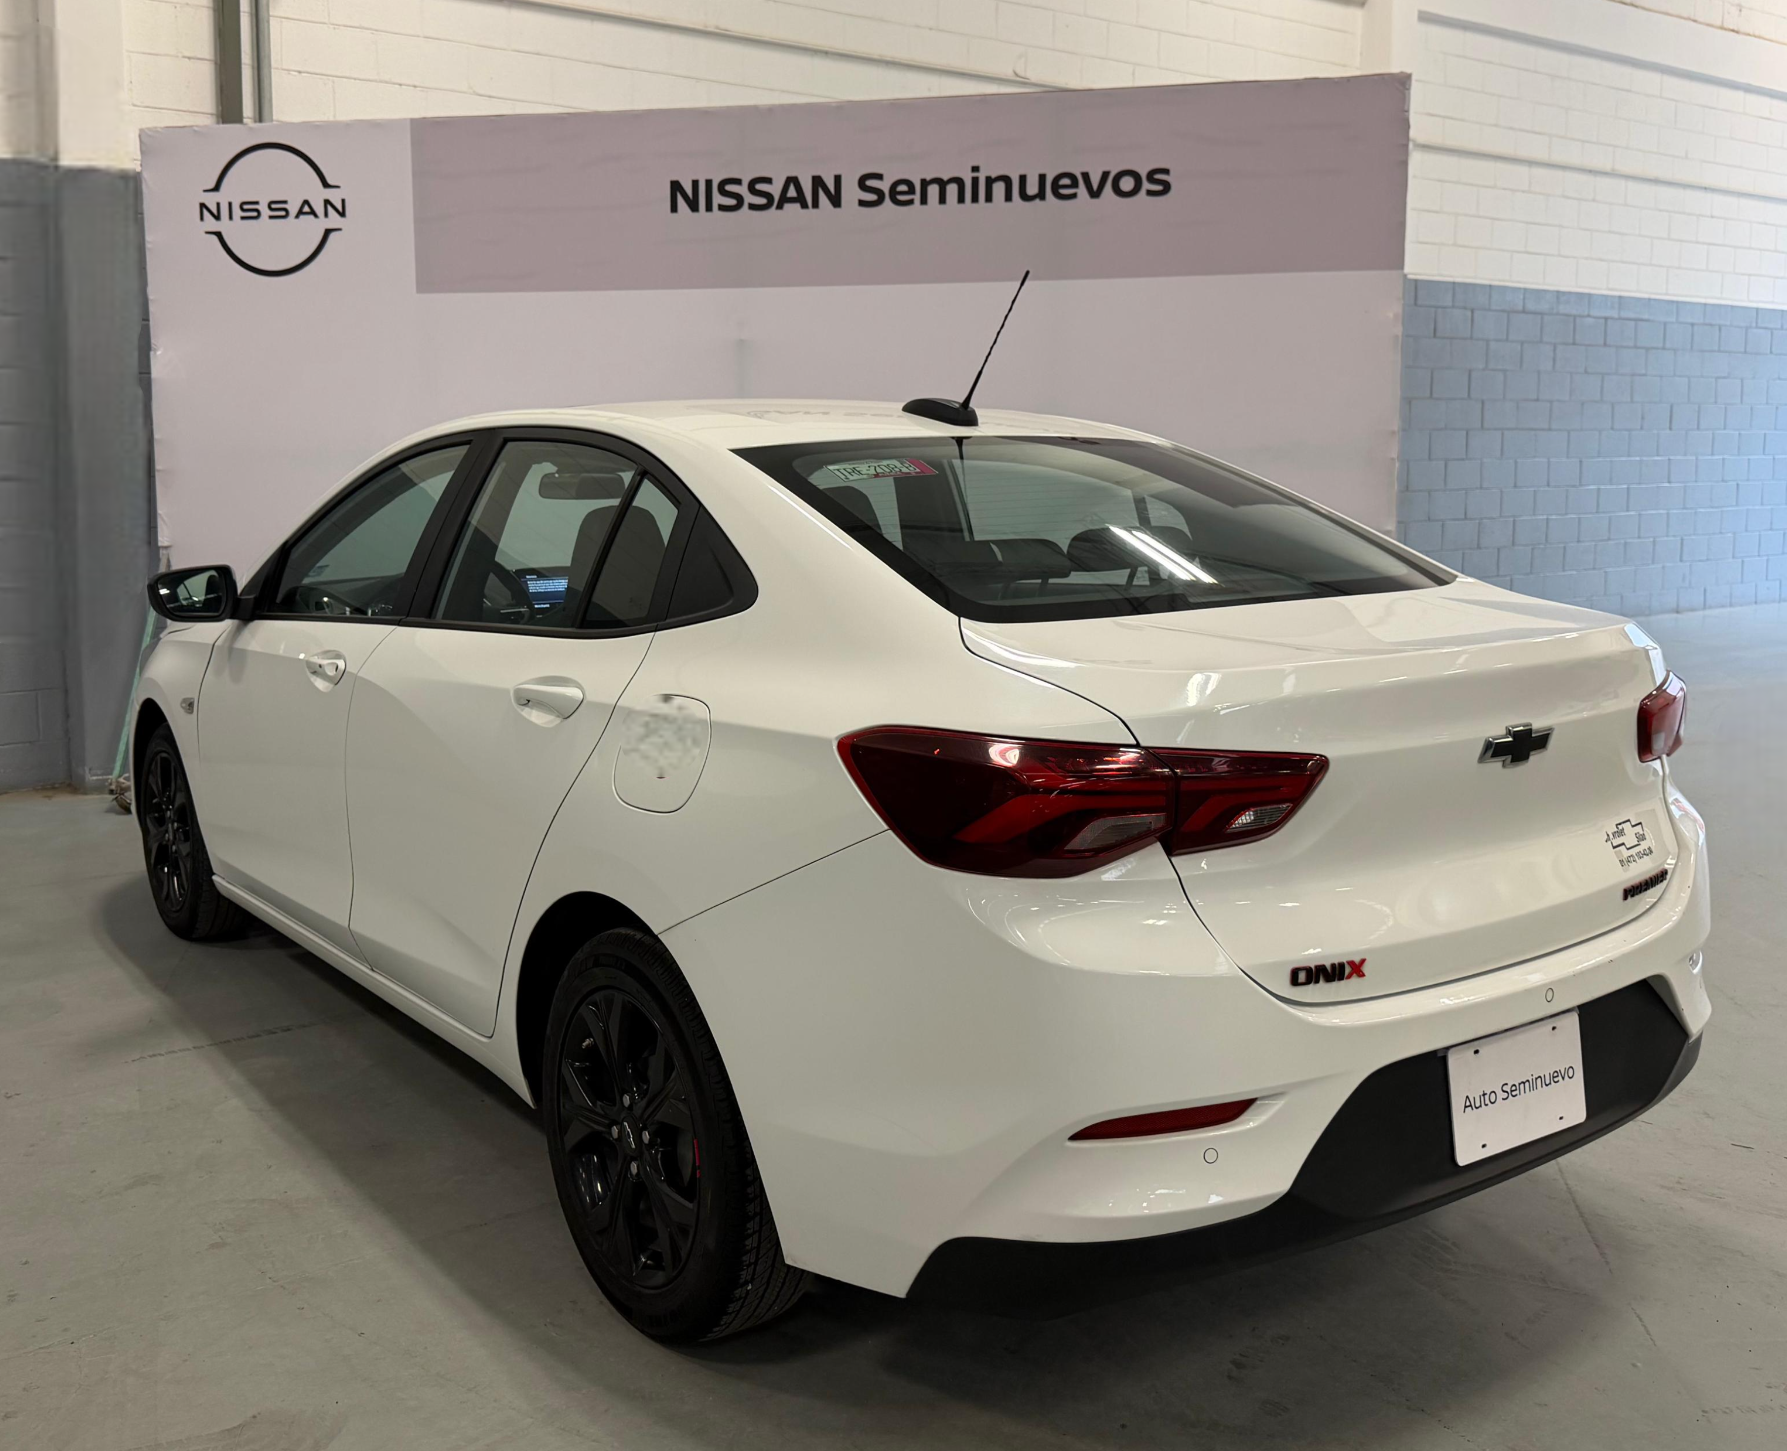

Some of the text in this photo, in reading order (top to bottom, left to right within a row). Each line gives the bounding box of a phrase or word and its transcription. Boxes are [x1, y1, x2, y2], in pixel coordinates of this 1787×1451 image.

[670, 165, 1172, 213] NISSAN Seminuevos
[199, 198, 346, 222] NISSAN
[1289, 958, 1367, 986] ONIX
[1462, 1065, 1576, 1114] Auto Seminuevo
